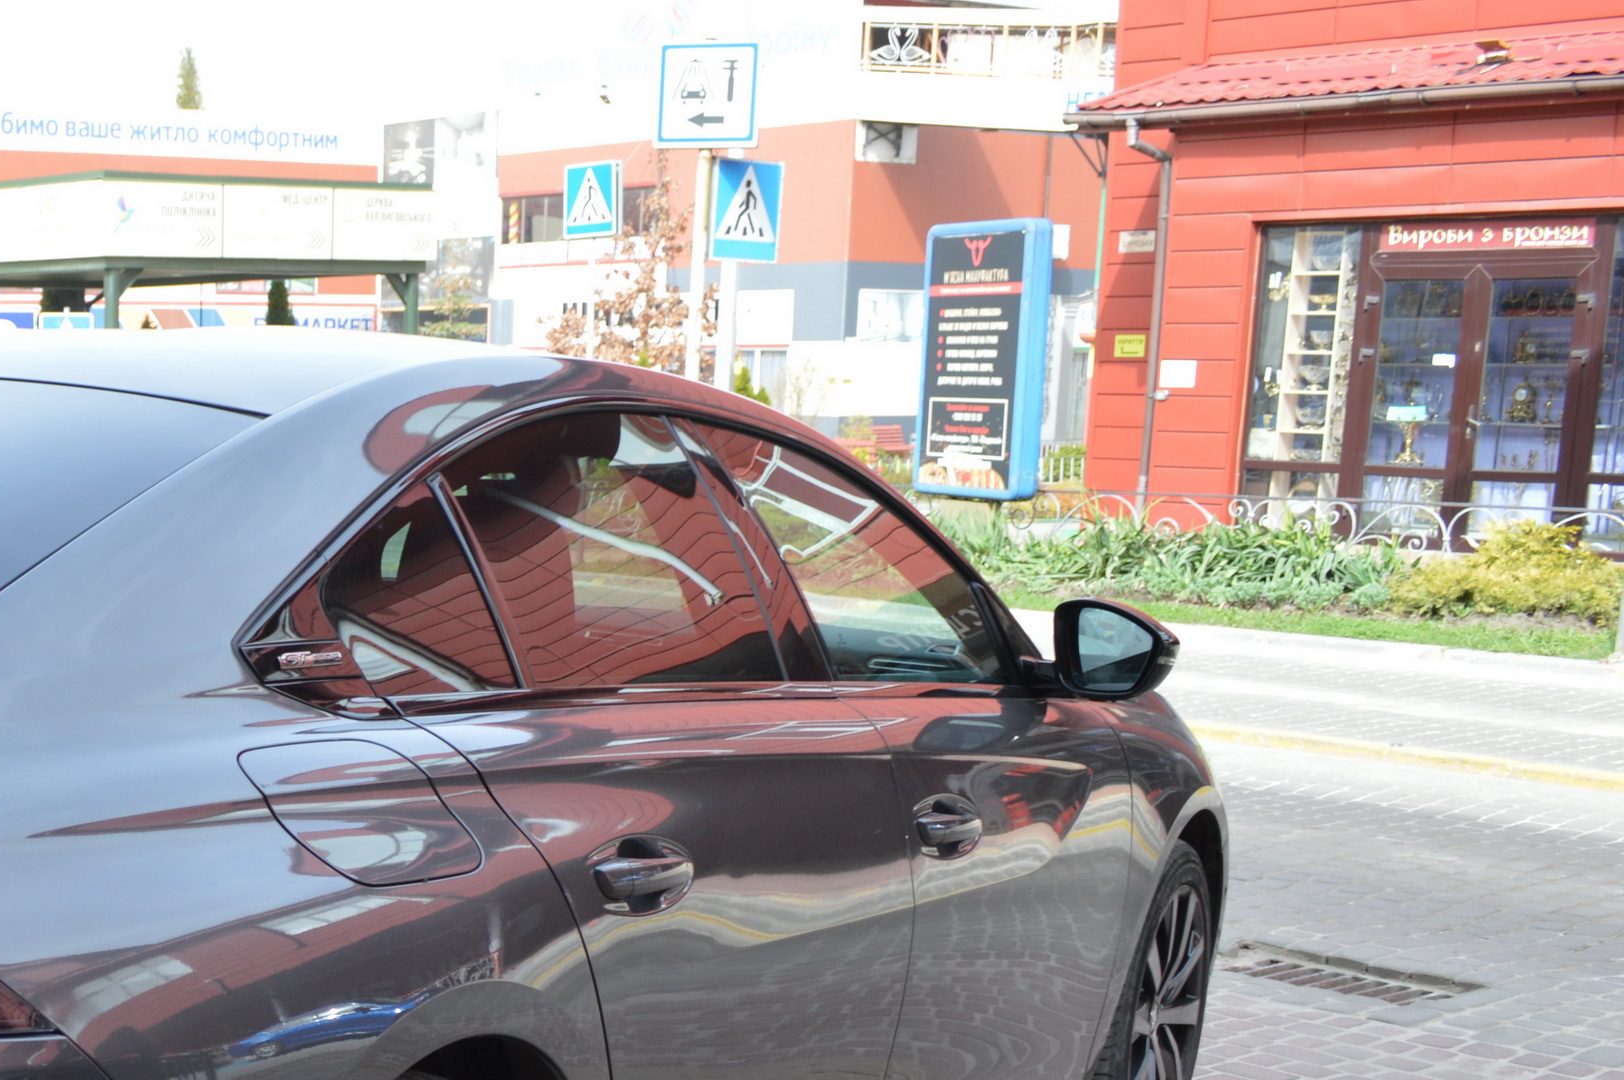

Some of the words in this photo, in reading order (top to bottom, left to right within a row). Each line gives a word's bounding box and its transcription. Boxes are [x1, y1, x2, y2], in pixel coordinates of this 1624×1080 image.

[65, 120, 122, 140] ваше
[128, 120, 200, 143] житло
[208, 124, 339, 150] комфортним
[1388, 224, 1474, 250] Вироби
[1480, 227, 1494, 243] з
[1501, 224, 1589, 248] бронзи
